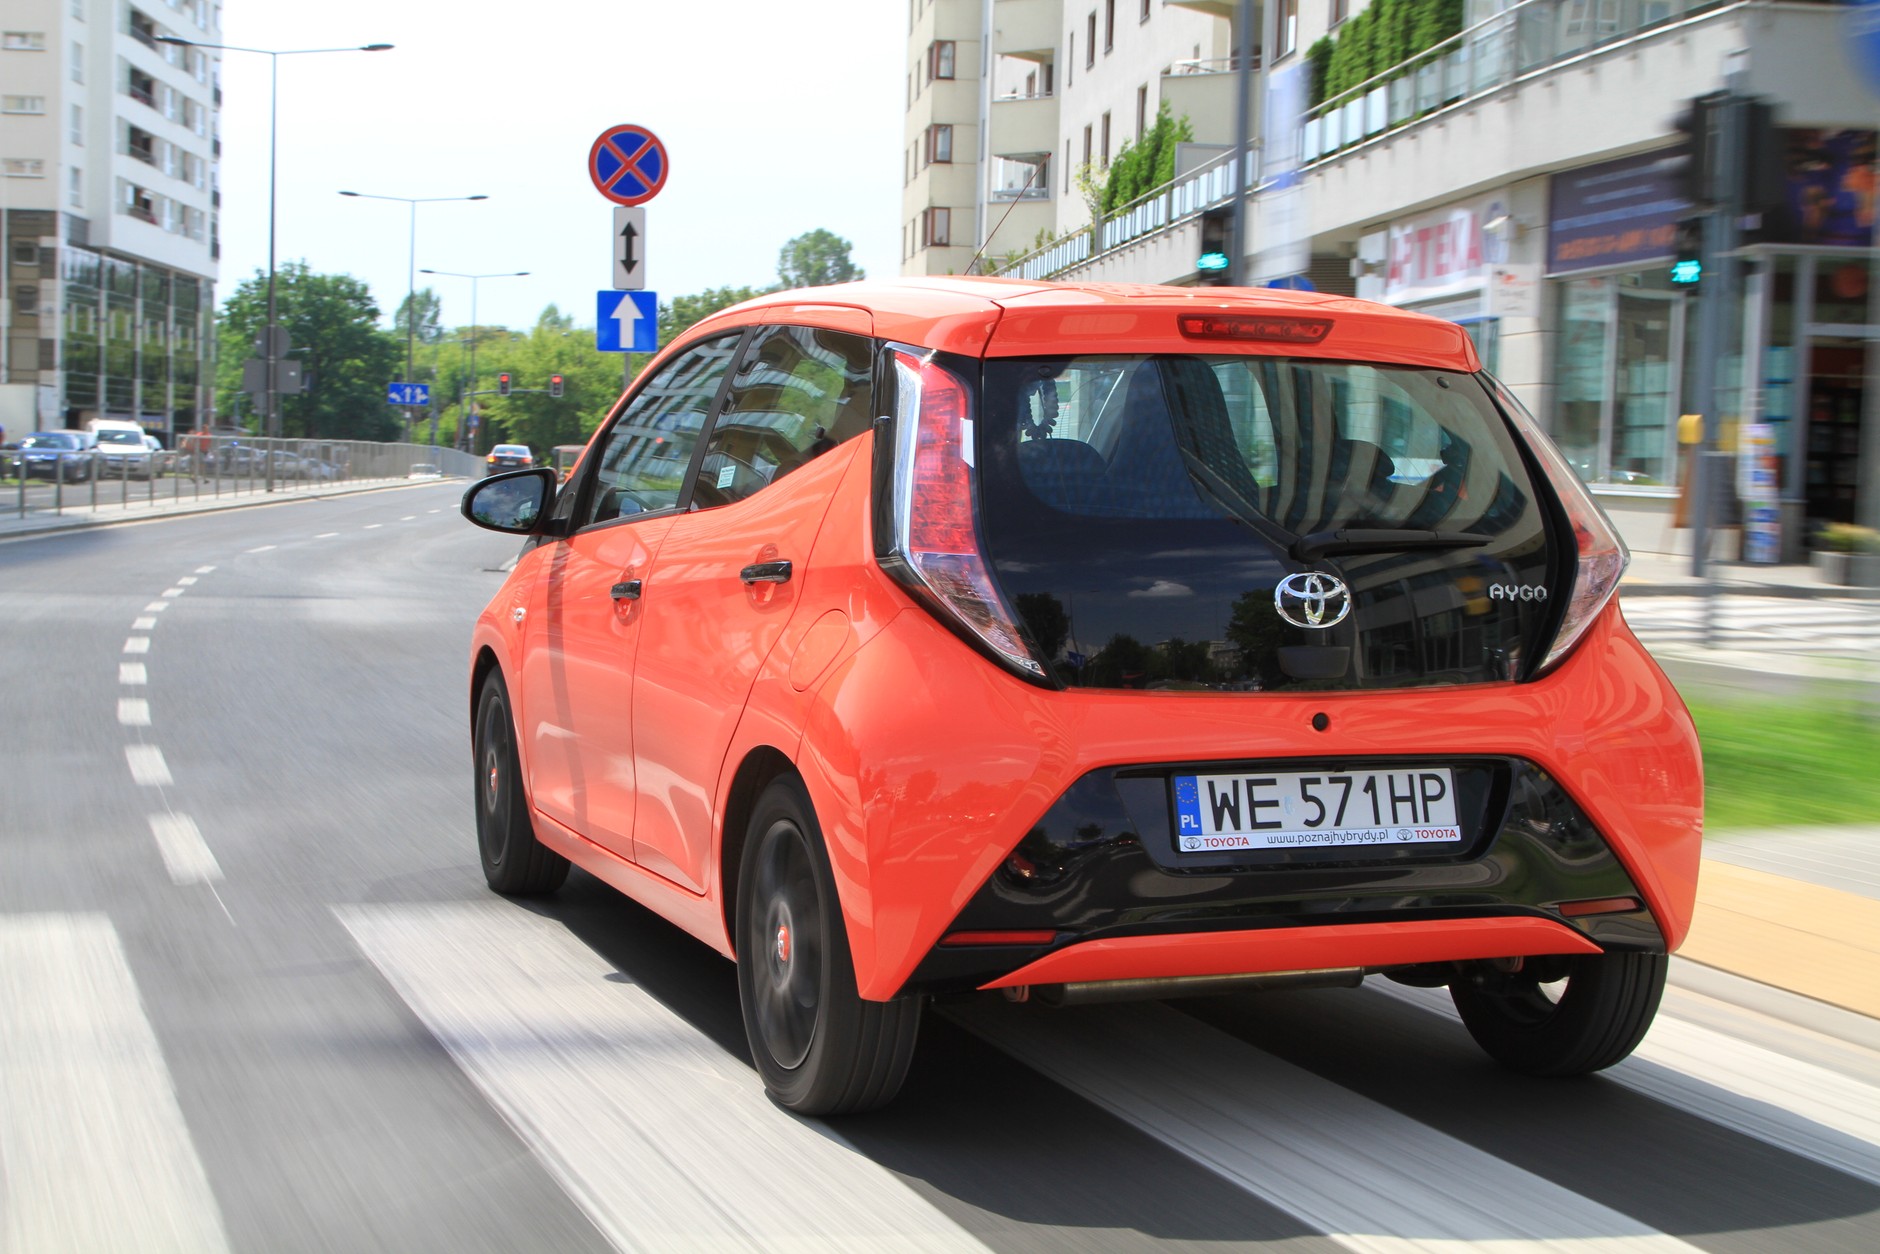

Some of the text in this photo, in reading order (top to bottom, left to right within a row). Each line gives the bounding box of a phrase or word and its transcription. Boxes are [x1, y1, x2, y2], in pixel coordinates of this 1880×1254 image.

[1489, 582, 1547, 602] AYGO
[1207, 773, 1446, 831] WE 571HP
[1181, 814, 1198, 828] PL
[1204, 829, 1457, 847] TOYOTA www.poznajhybrydy.pl TOYOTA
